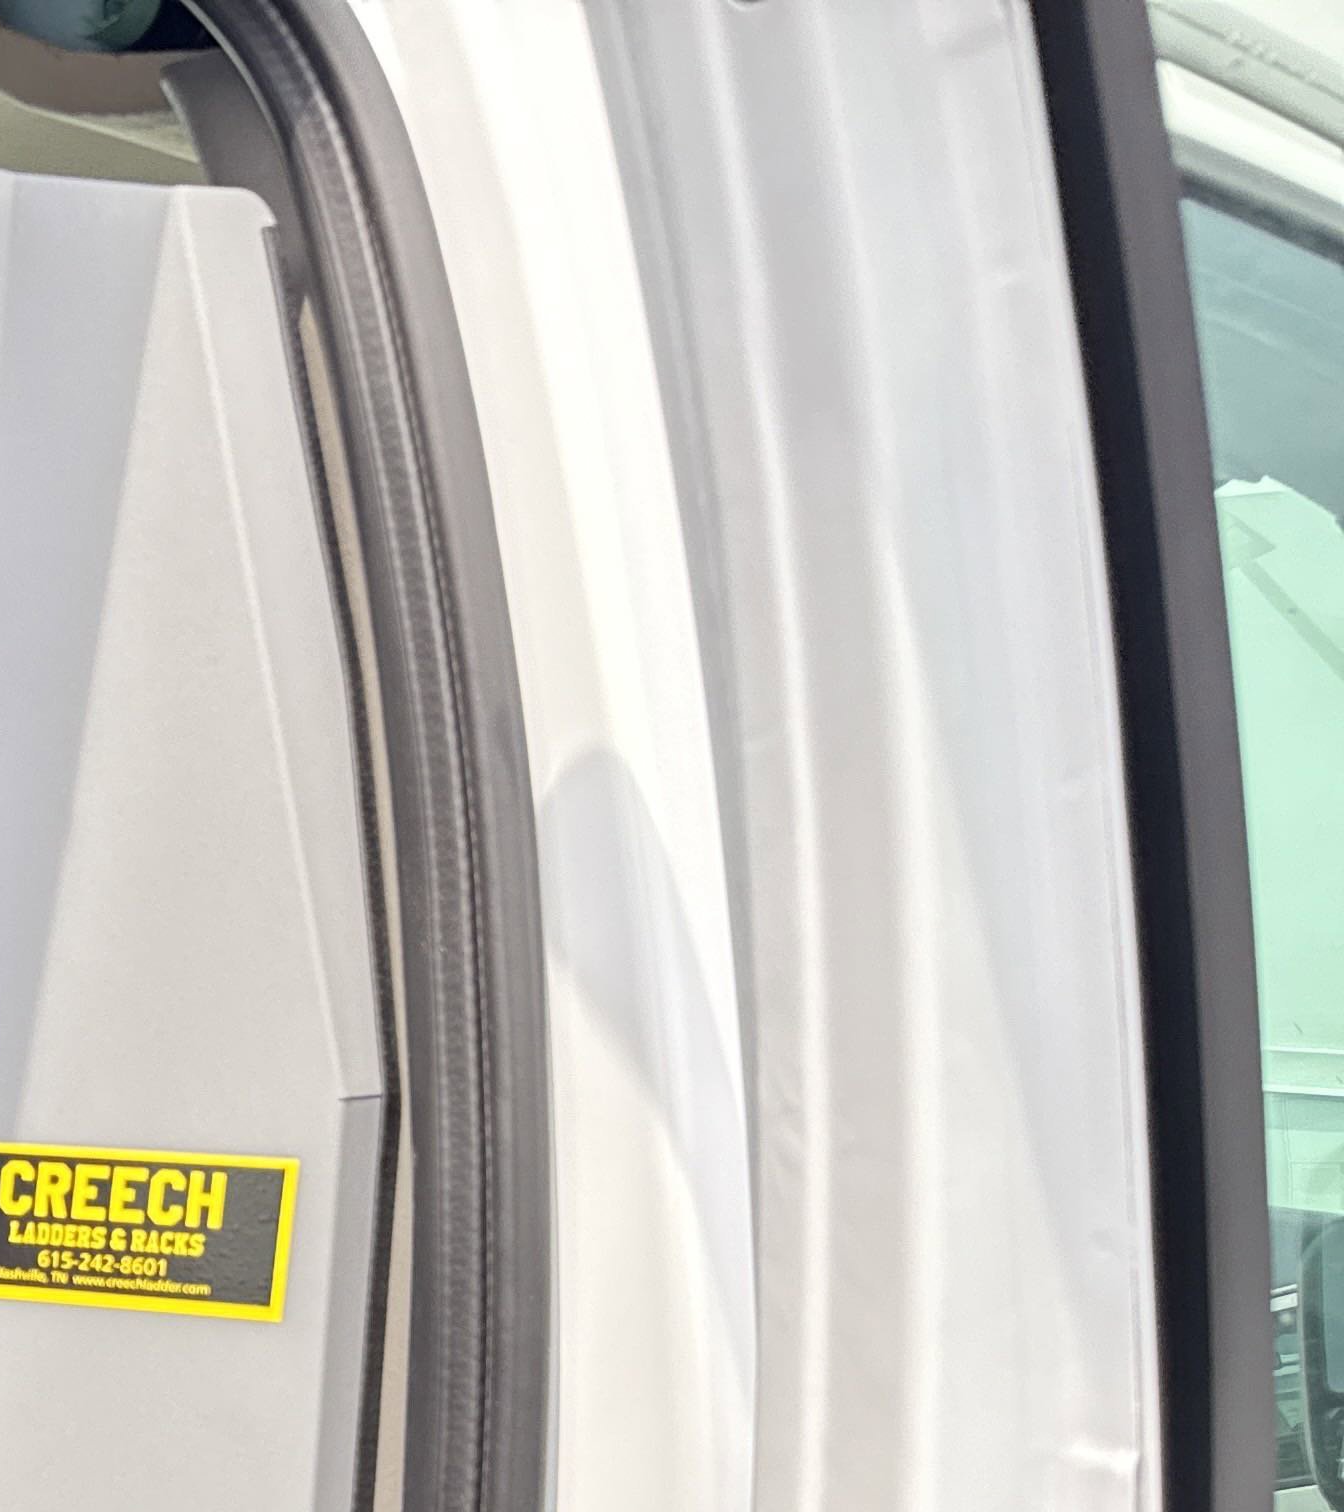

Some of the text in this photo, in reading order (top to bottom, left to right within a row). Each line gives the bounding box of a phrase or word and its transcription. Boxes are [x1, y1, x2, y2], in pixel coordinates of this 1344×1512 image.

[8, 1219, 206, 1257] LADDERS & RACKS
[37, 1249, 168, 1277] 615-242-8601
[50, 1271, 69, 1284] TN
[72, 1274, 211, 1296] www.creechladder.com
